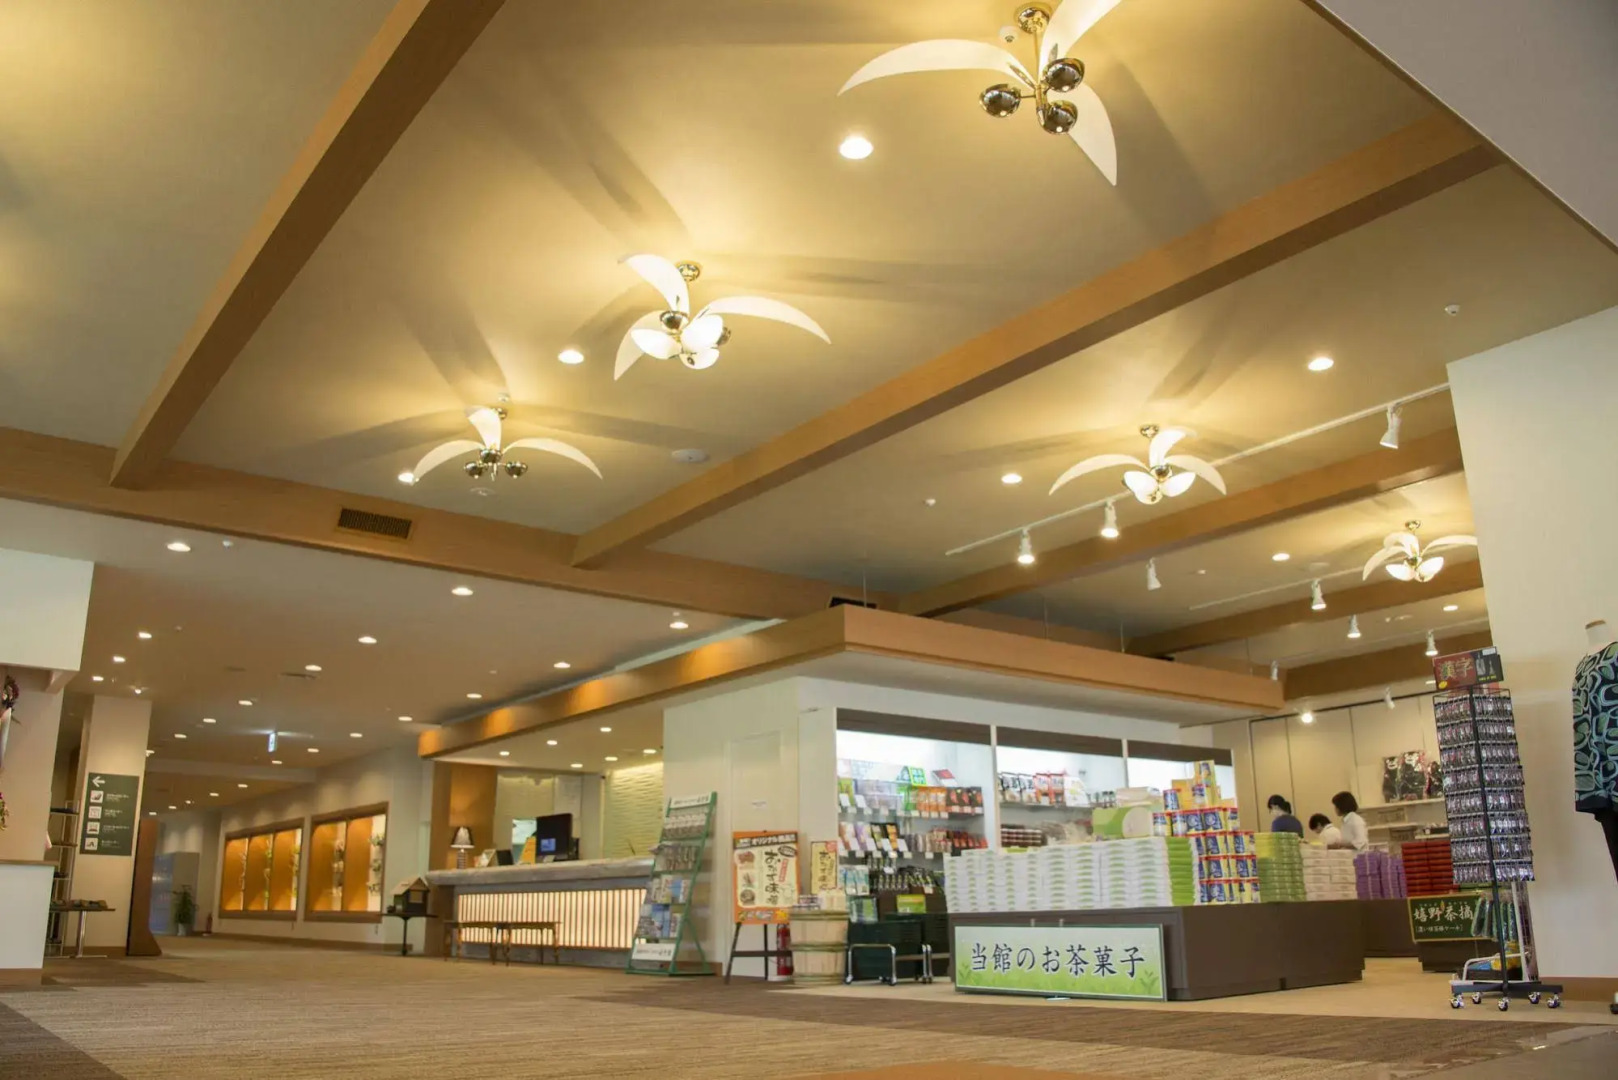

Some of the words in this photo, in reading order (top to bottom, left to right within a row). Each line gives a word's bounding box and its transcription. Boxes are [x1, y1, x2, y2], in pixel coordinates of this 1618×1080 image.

[970, 942, 1145, 979] 当館のお茶菓子
